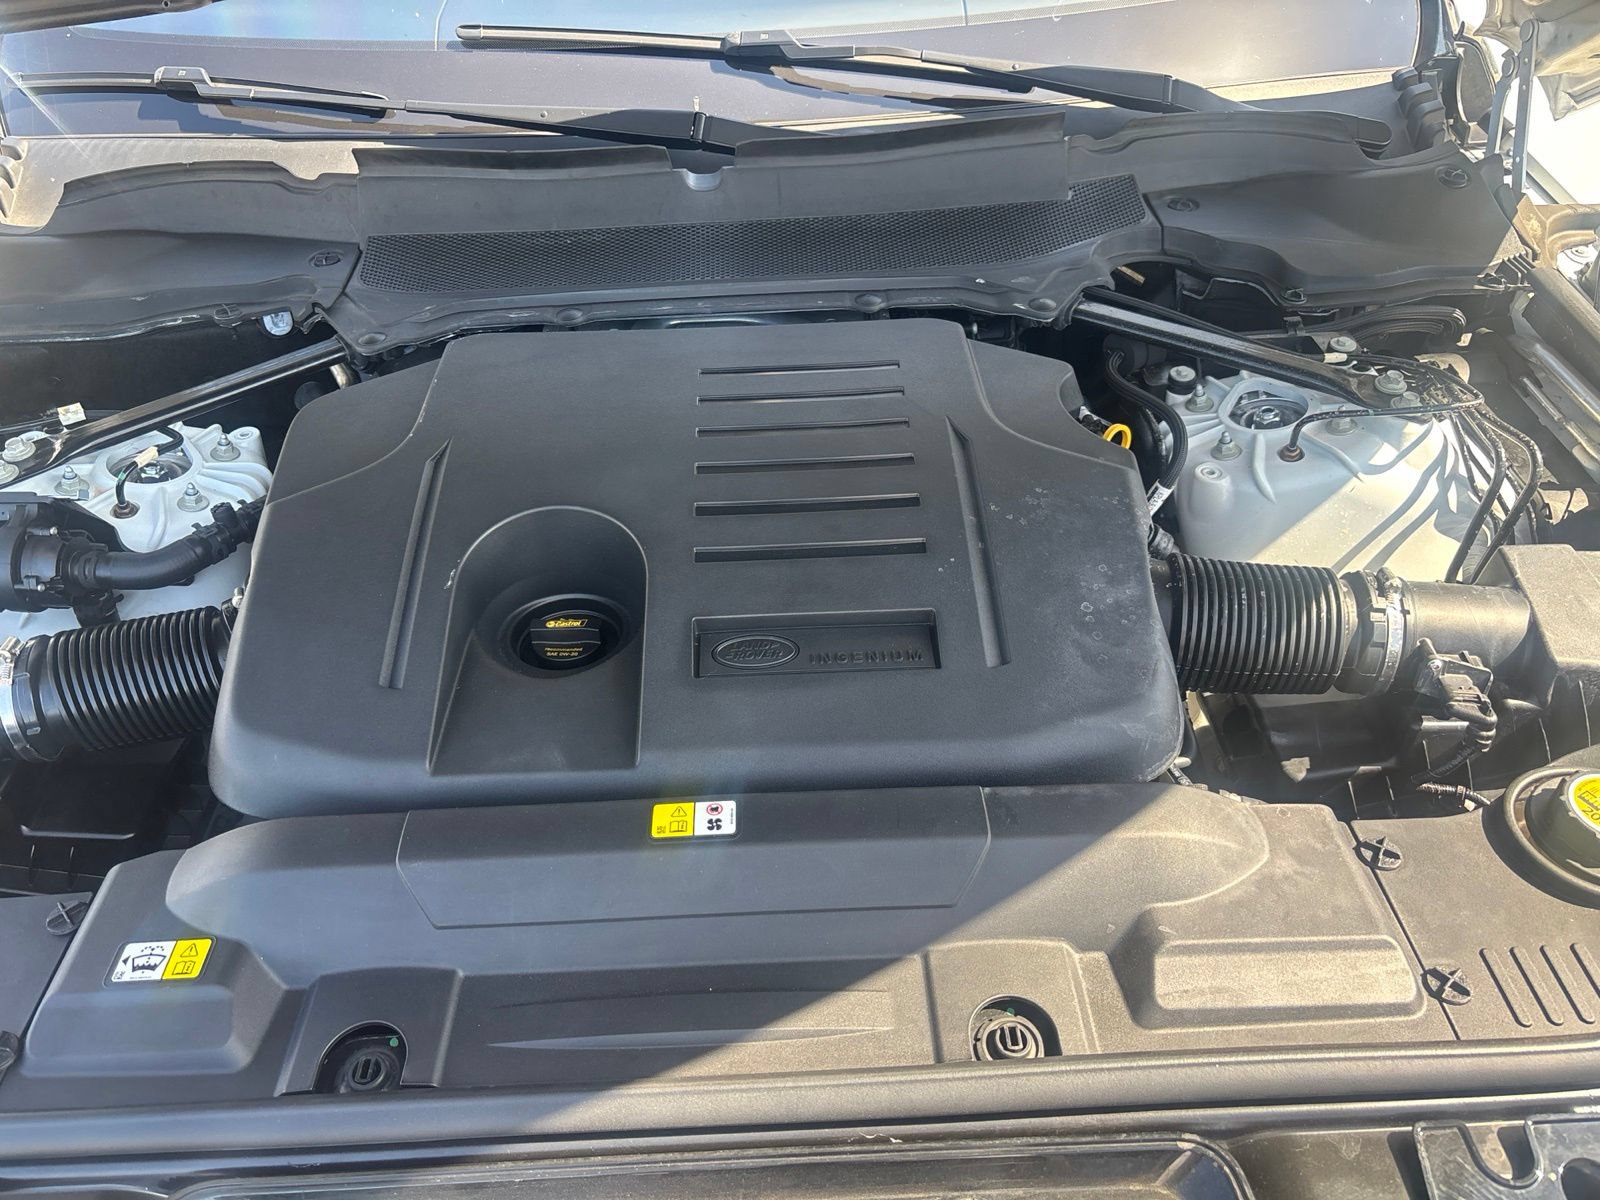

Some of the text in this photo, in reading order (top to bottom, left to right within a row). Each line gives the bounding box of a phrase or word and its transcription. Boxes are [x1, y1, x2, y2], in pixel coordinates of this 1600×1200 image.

[555, 619, 581, 628] Castrol
[732, 640, 774, 651] LAND
[733, 649, 783, 661] ROVER
[808, 649, 925, 665] INGENIUM
